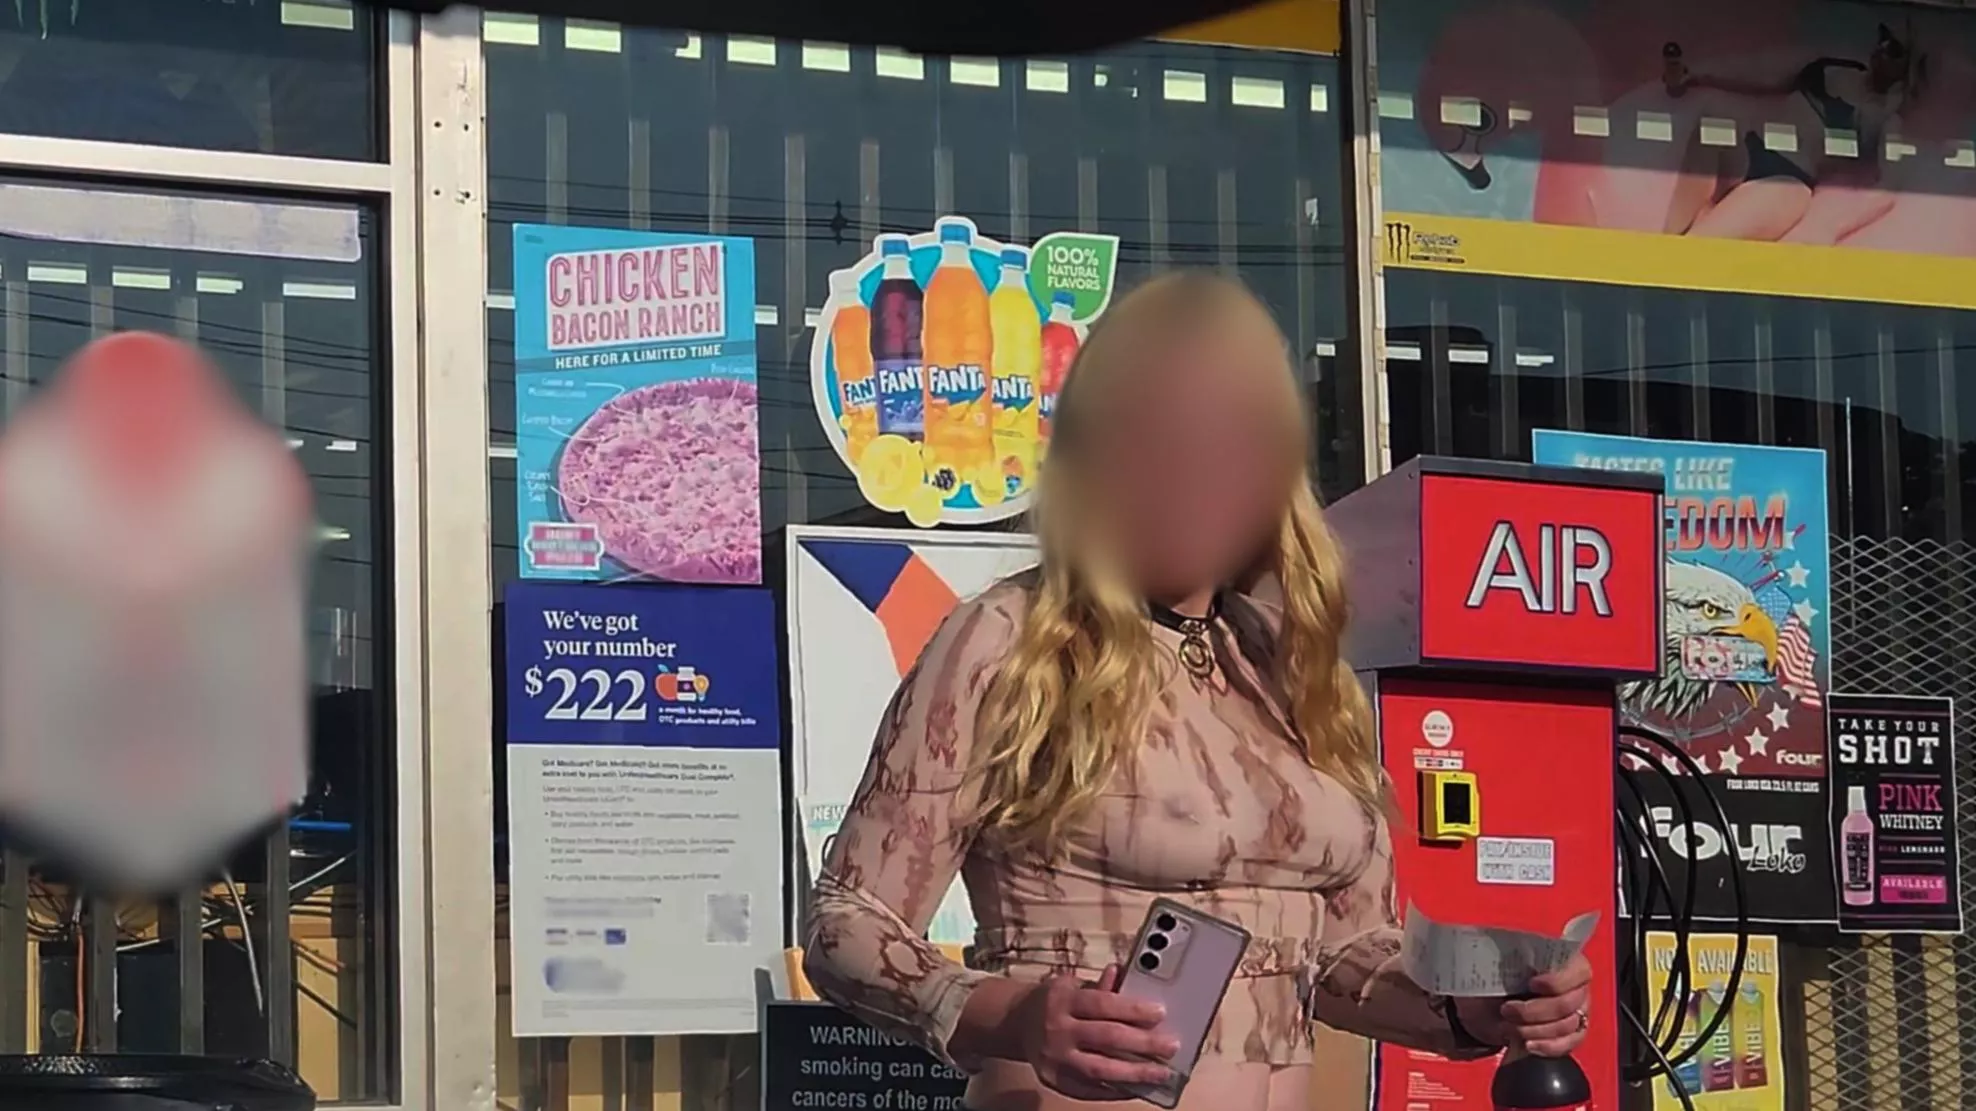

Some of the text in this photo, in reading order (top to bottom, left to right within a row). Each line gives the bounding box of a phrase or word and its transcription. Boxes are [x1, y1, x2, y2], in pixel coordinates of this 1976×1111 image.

[1047, 246, 1099, 266] 100%
[549, 245, 719, 307] CHICKEN
[1047, 264, 1100, 278] NATURAL
[1047, 276, 1101, 290] FLAVORS
[552, 301, 721, 346] BACON RANCH
[555, 344, 722, 370] HERE FOR A LIMITED TIME
[844, 379, 876, 403] FAN
[879, 367, 923, 394] FANT
[928, 364, 986, 393] FANTA
[992, 376, 1033, 400] ANTA
[1674, 456, 1736, 491] LIKE
[1665, 493, 1788, 551] EDOM
[1464, 520, 1613, 618] AIR
[543, 610, 639, 636] We've got
[544, 637, 677, 660] your number
[525, 664, 647, 721] $222
[1838, 718, 1940, 733] TAKE YOUR
[1775, 749, 1824, 766] four
[1838, 734, 1941, 764] SHOT
[1878, 783, 1944, 812] PINK
[1879, 813, 1944, 830] WHITNEY
[1882, 878, 1944, 889] AVAILABLE
[1653, 948, 1773, 975] NO AVAIBLE
[800, 1056, 883, 1081] smoking
[889, 1063, 924, 1078] can
[792, 1090, 868, 1108] cancers
[873, 1088, 893, 1109] of
[897, 1089, 928, 1111] the
